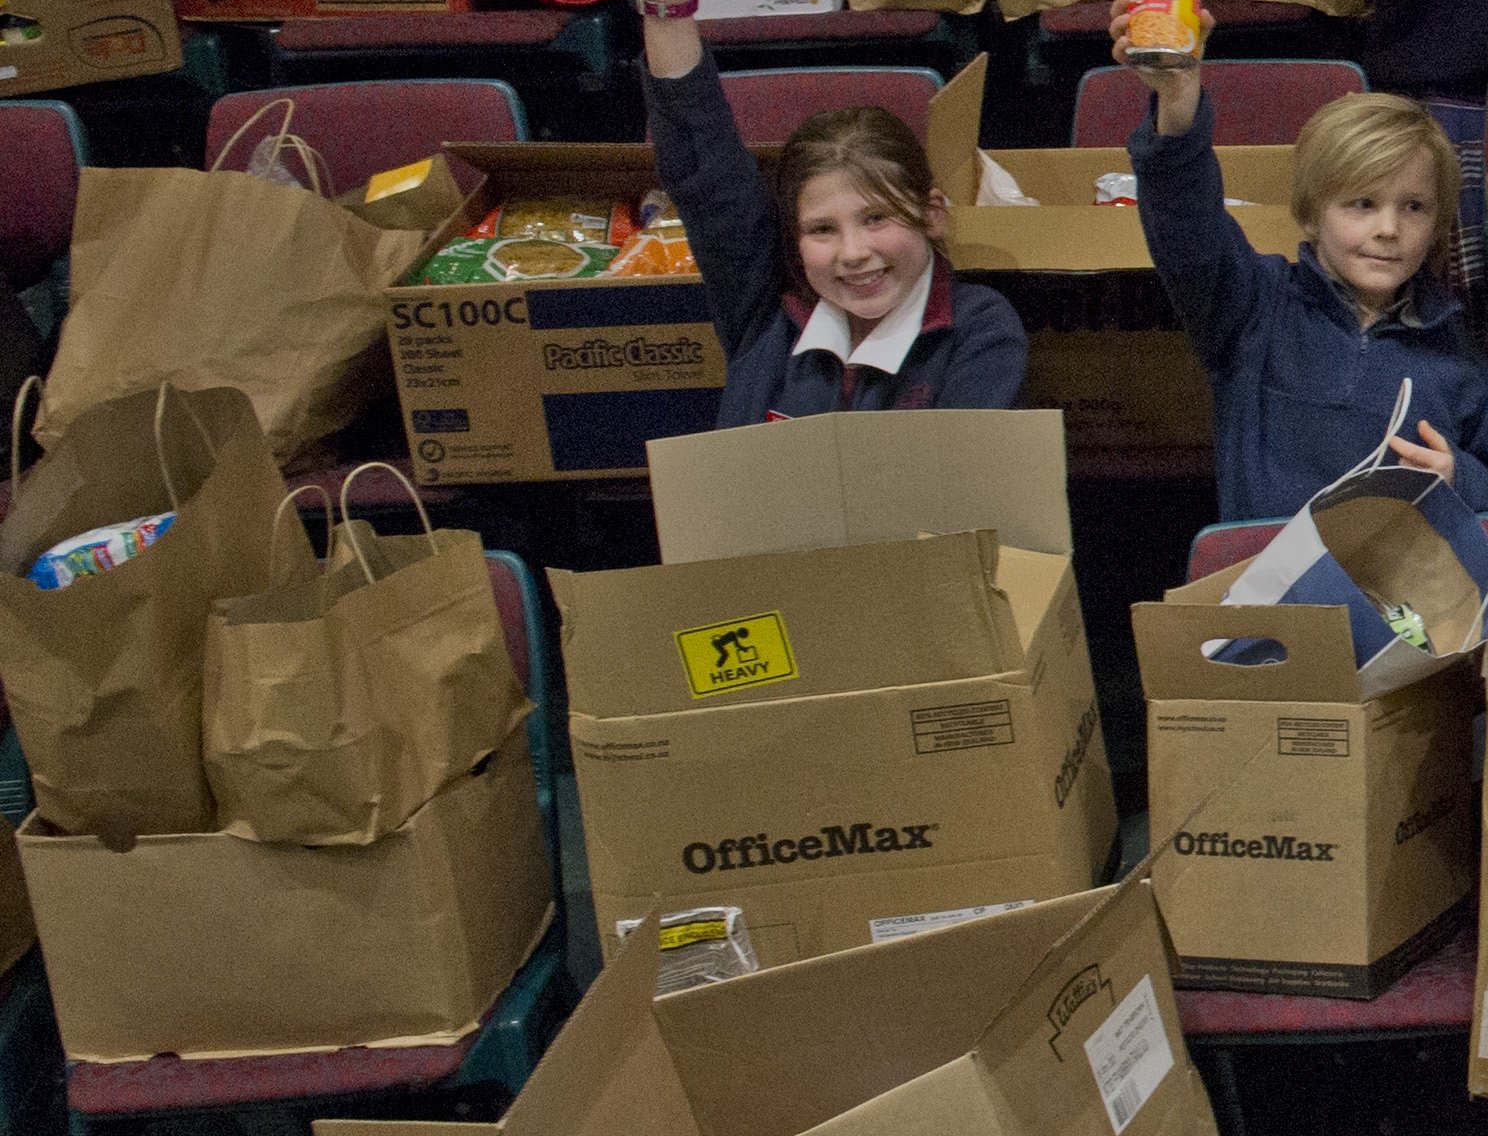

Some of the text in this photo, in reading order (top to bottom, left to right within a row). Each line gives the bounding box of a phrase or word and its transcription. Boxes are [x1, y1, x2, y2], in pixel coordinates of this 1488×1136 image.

[392, 298, 527, 330] SC100C
[545, 336, 704, 370] Pacific Classic
[709, 660, 771, 686] HEAVY
[683, 823, 933, 876] OfficeMax
[1174, 831, 1334, 862] OfficeMax
[874, 915, 926, 928] OFFICEMAX
